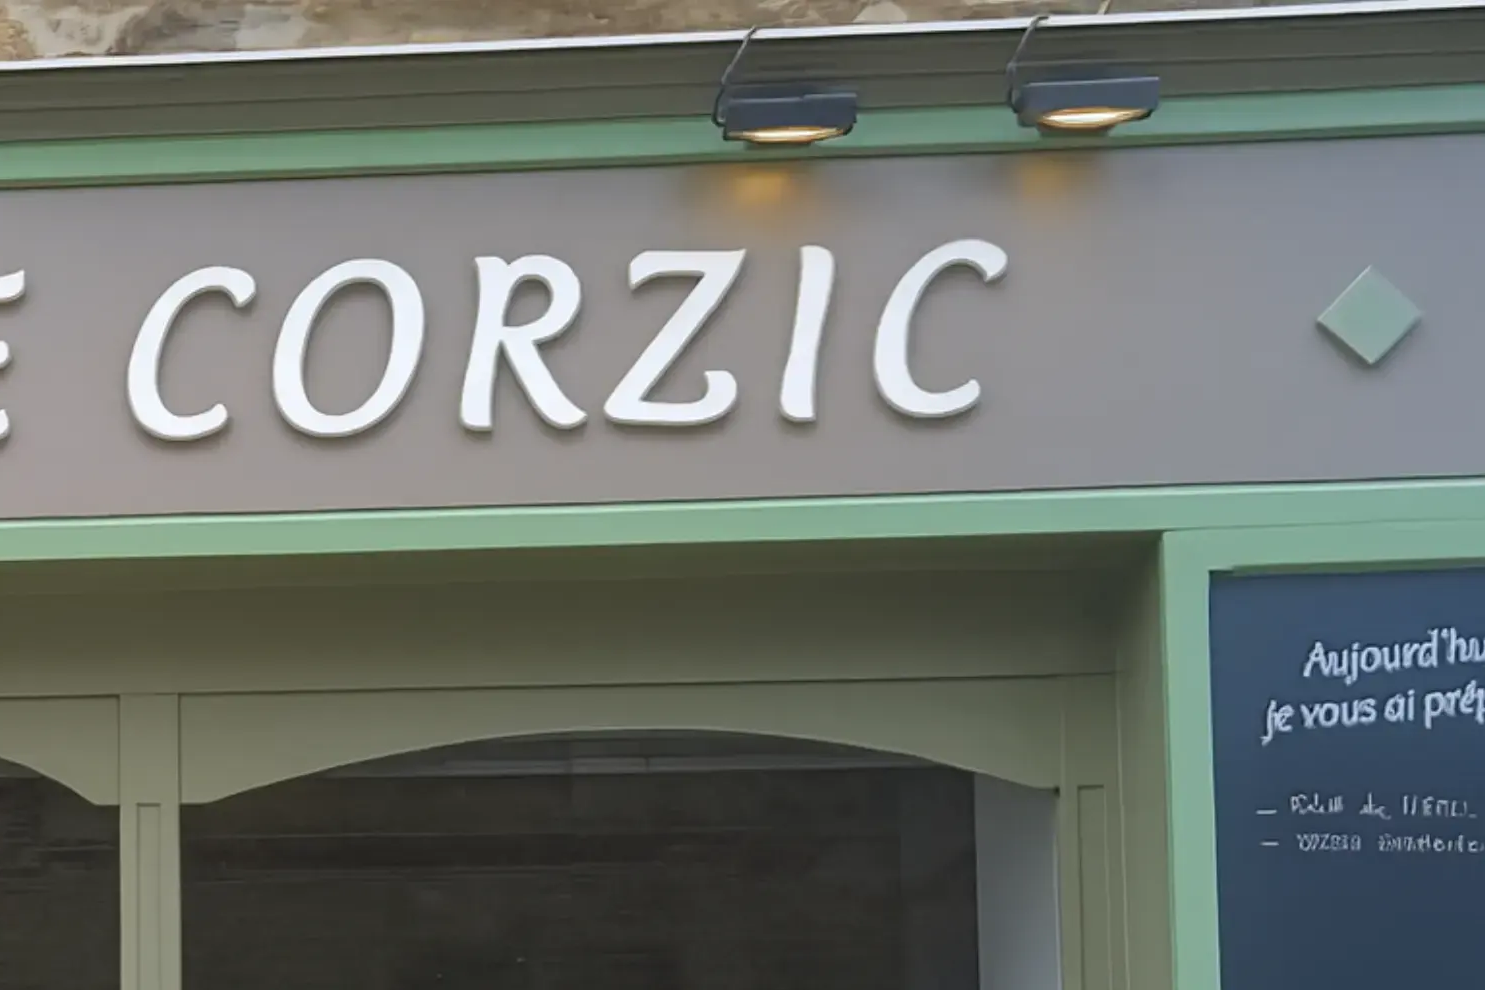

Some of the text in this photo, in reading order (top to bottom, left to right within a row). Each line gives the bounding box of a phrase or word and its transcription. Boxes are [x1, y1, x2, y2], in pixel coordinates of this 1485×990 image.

[126, 238, 1008, 443] CORZIC
[1301, 698, 1376, 729] vous
[1384, 690, 1415, 722] ai
